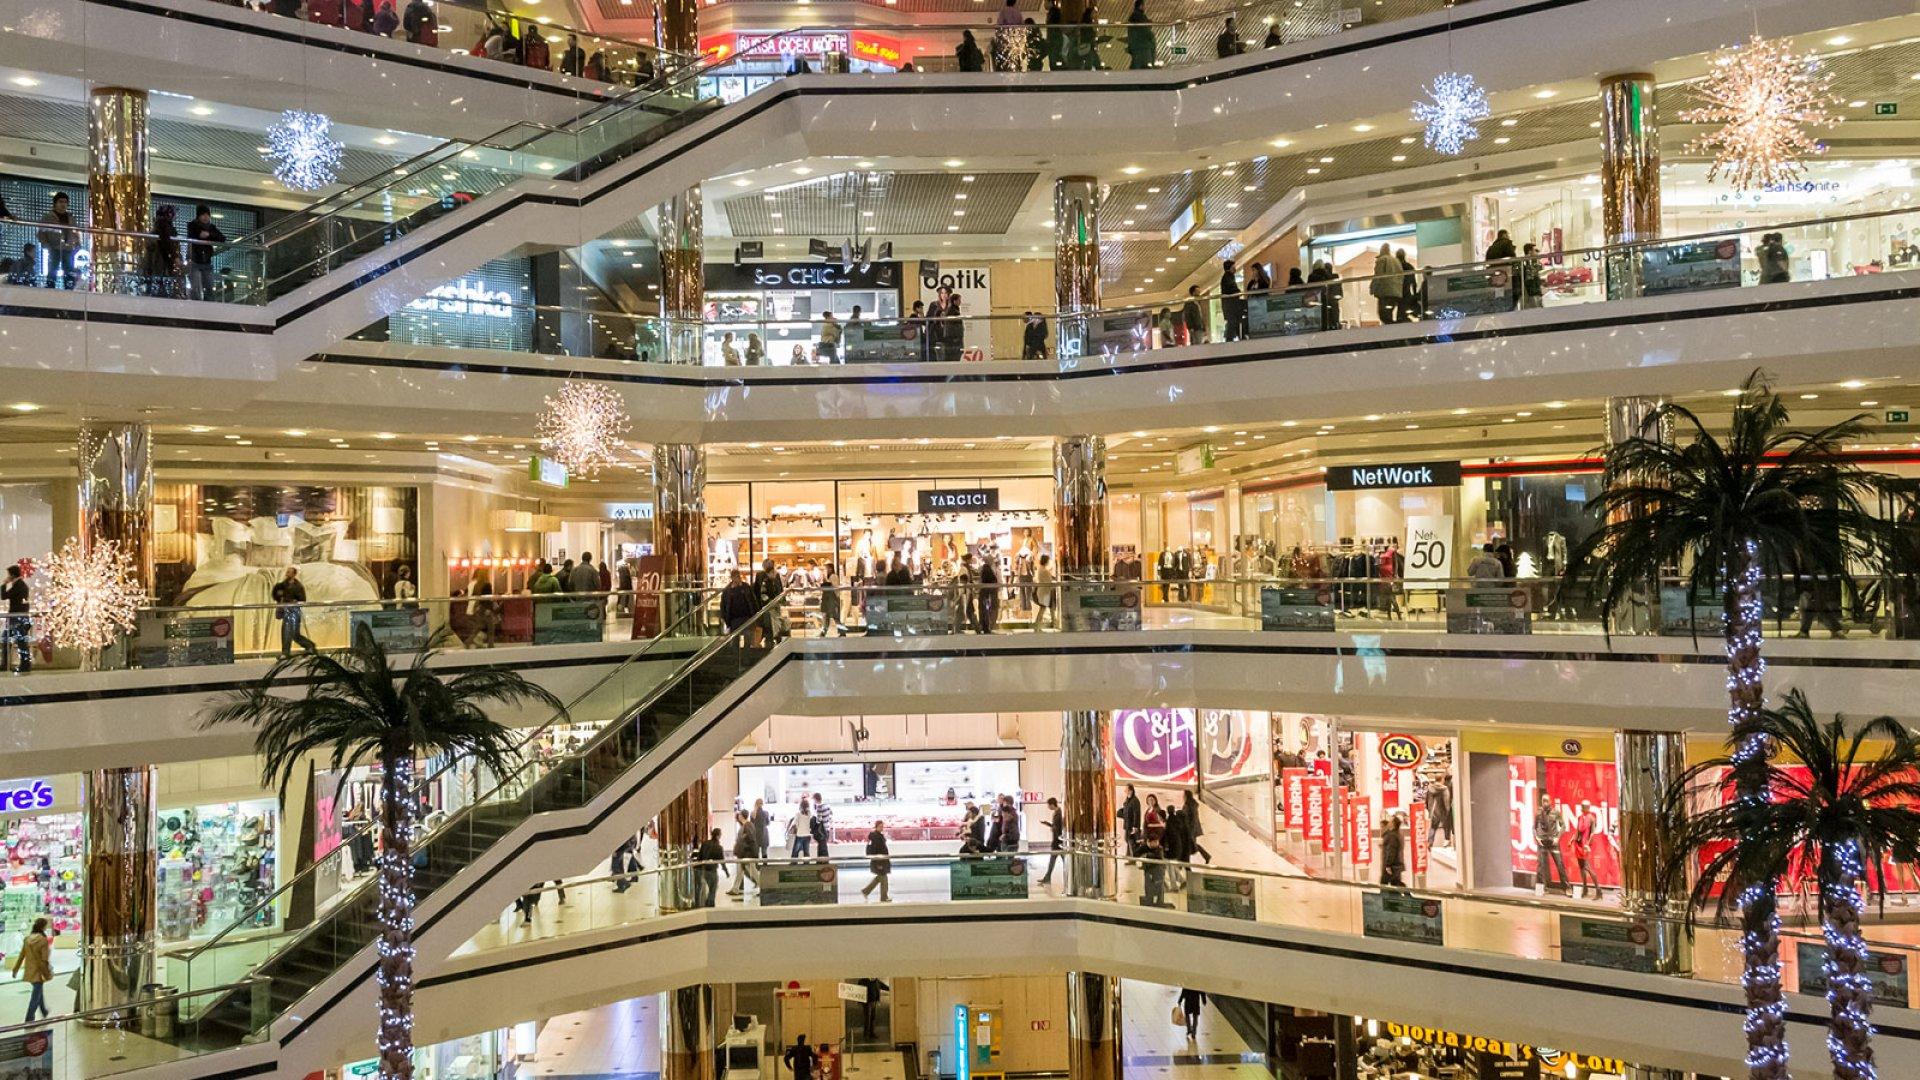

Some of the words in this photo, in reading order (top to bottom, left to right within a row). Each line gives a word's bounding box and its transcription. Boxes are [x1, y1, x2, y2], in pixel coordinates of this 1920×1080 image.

[1764, 180, 1841, 193] Samsonite
[1352, 466, 1433, 486] NetWork
[930, 494, 987, 506] YARGICI
[1411, 541, 1446, 569] 50
[1123, 708, 1196, 762] C&A
[769, 755, 799, 764] IVON
[1385, 742, 1415, 762] C&A
